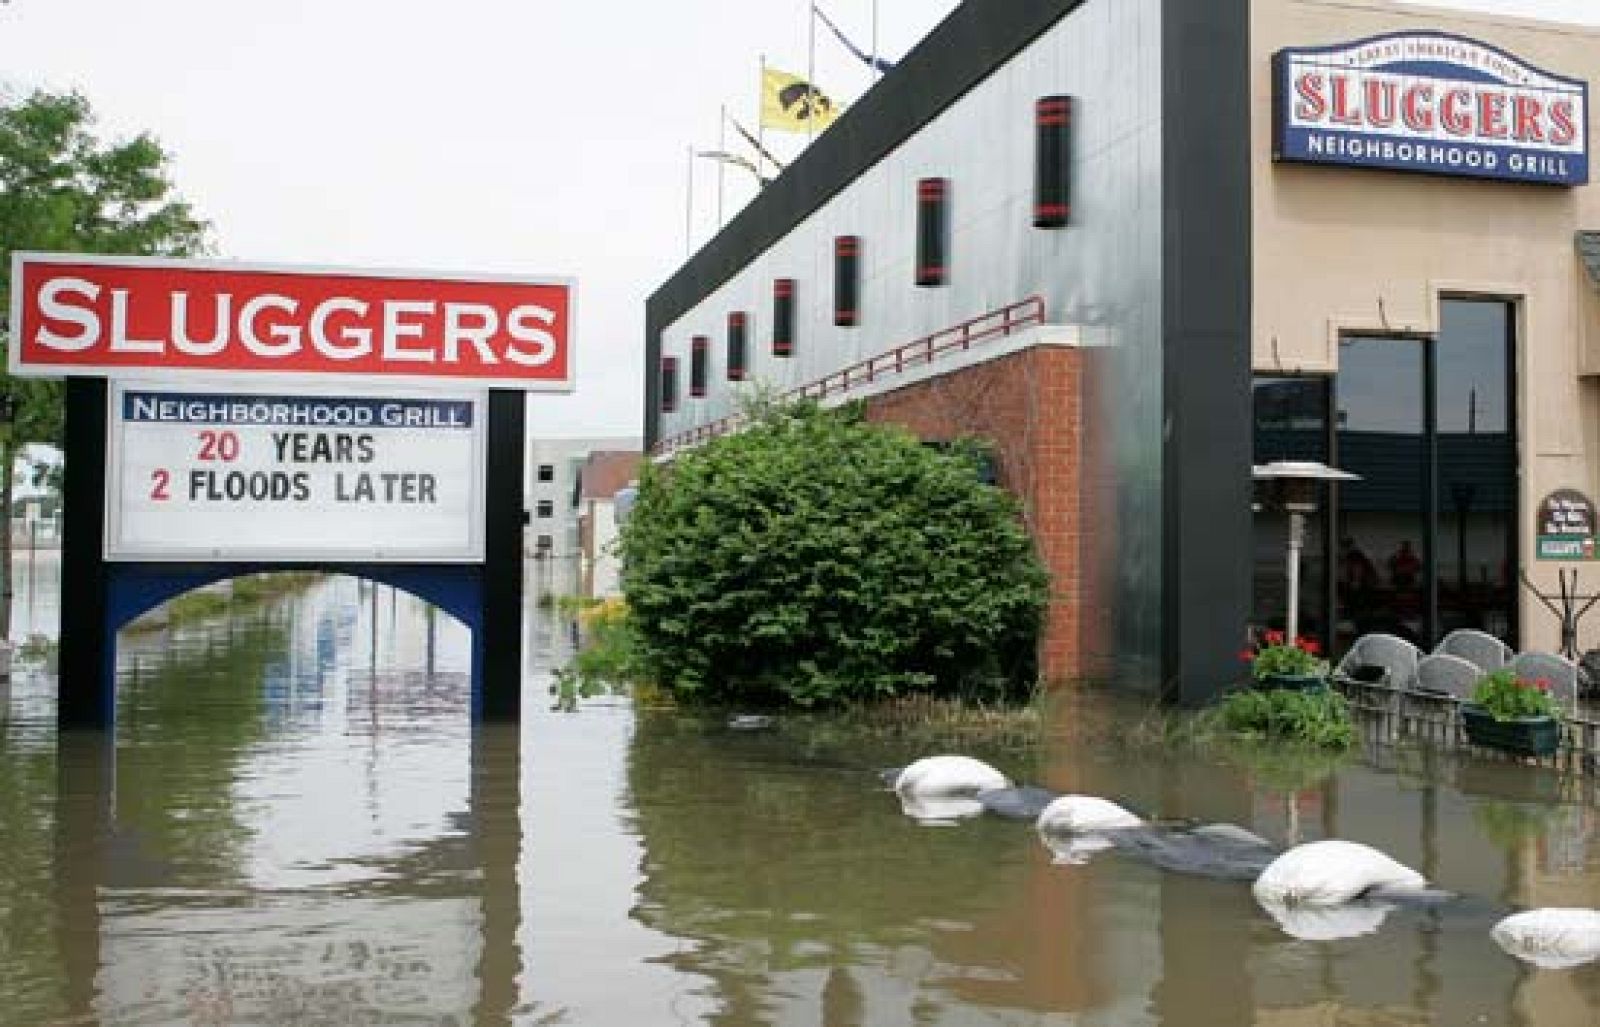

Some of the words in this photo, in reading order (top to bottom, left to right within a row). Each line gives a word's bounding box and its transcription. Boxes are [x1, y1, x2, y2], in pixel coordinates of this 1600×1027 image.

[1295, 72, 1577, 145] SLUGGERS
[1308, 134, 1498, 169] NEIGHBORHOOD
[1508, 153, 1569, 175] GRILL
[34, 277, 557, 367] SLUGGERS
[133, 396, 373, 426] NEIGHBORHOOD
[381, 404, 465, 426] GRILL
[197, 430, 240, 462] 20
[272, 432, 375, 463] YEARS
[150, 469, 171, 501] 2
[188, 470, 310, 502] FLOODS
[335, 472, 437, 503] LATER
